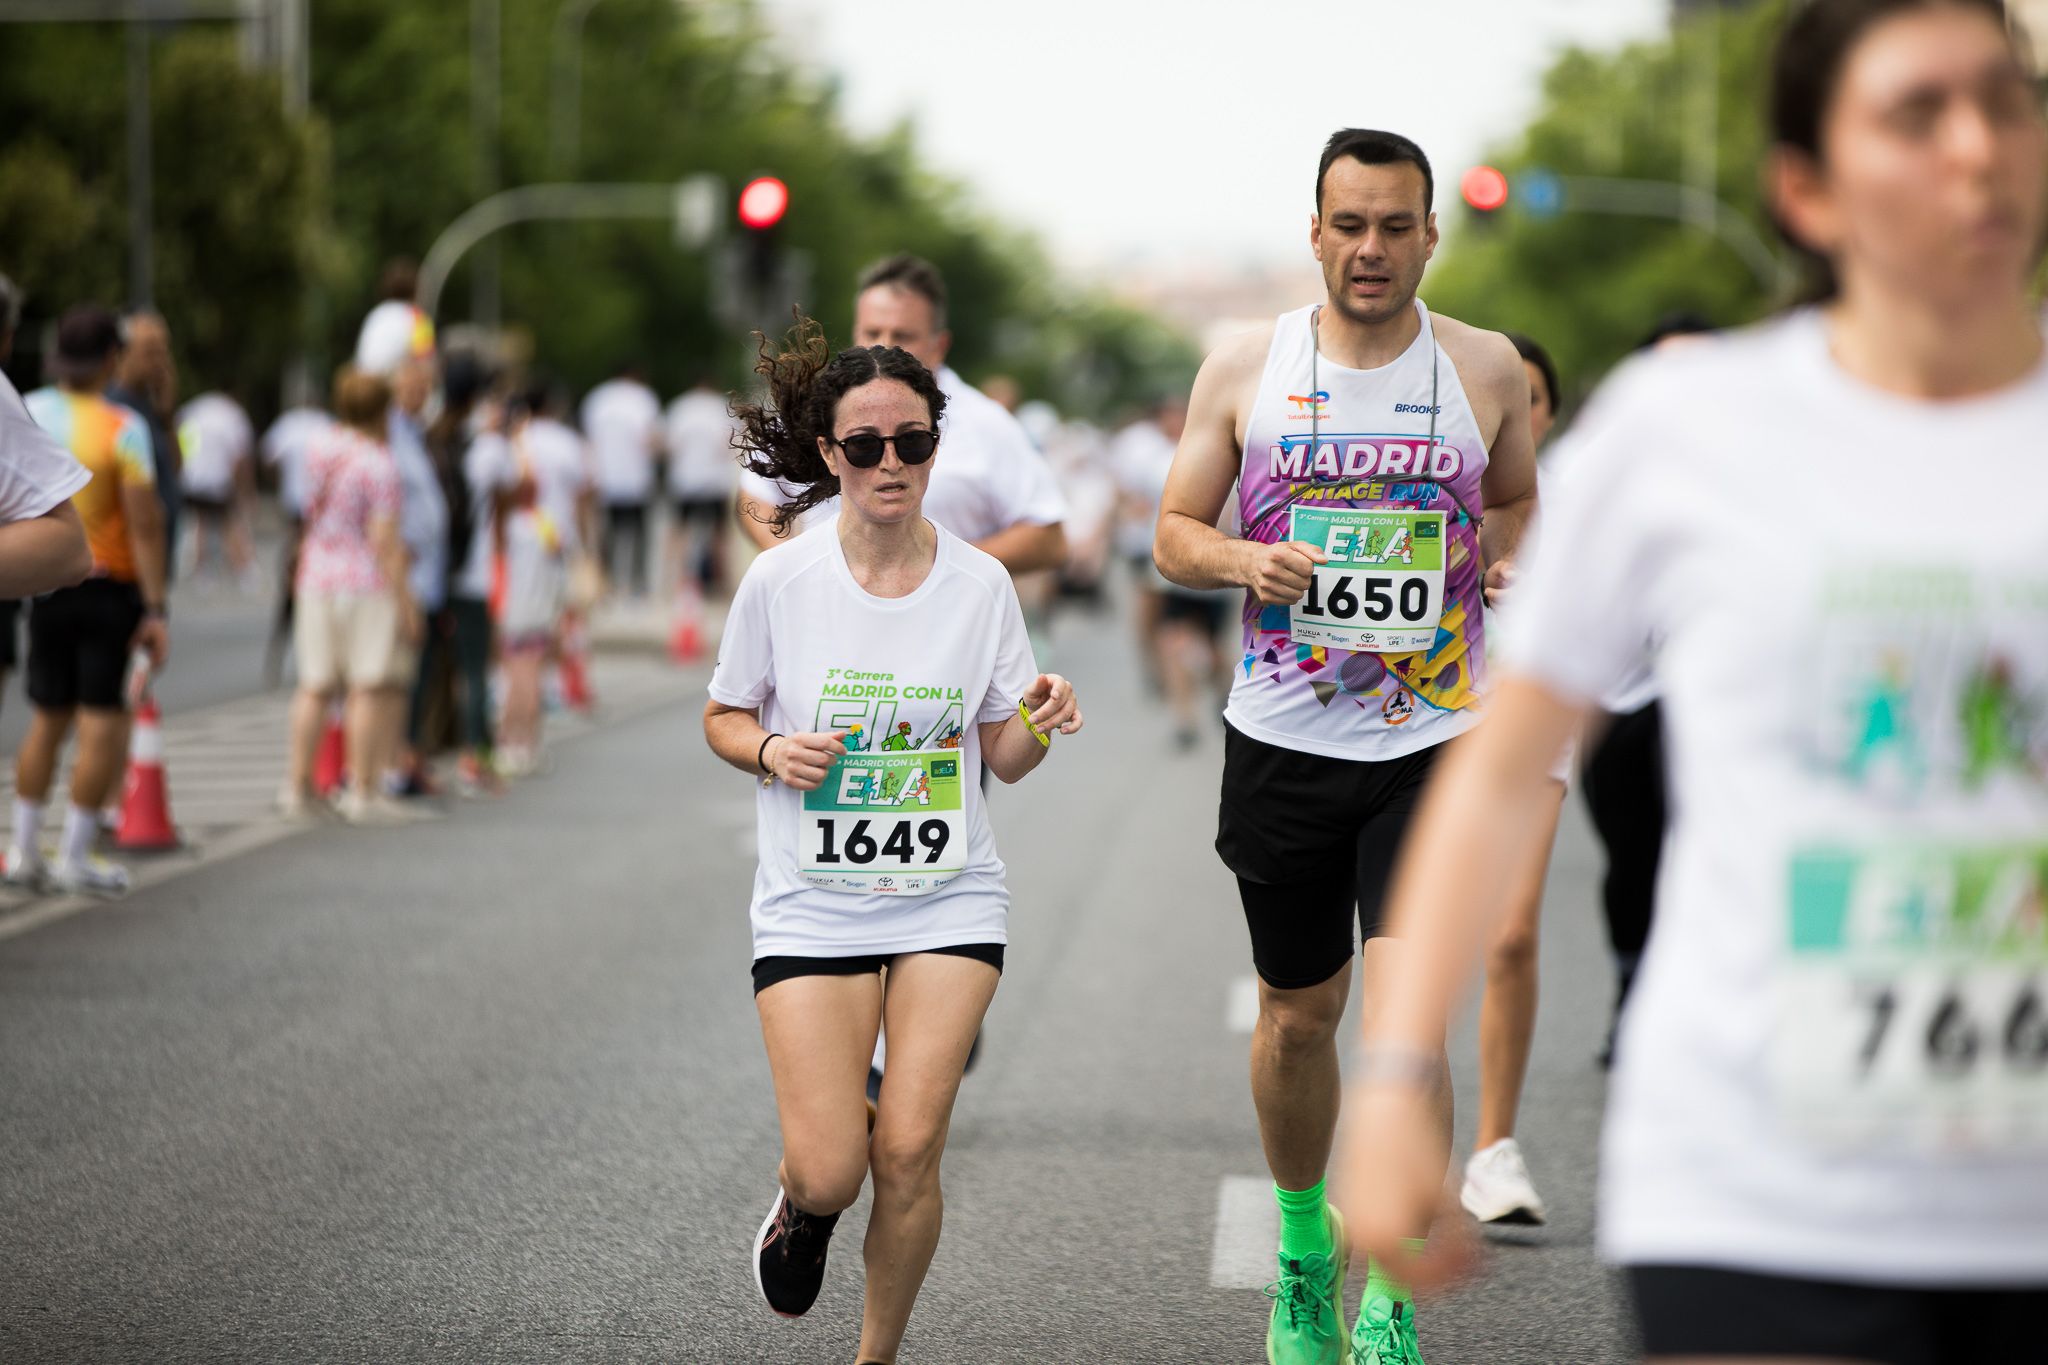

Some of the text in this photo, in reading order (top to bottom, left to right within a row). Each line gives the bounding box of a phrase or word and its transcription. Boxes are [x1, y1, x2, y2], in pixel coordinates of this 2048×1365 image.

[1394, 403, 1441, 415] BROOKS
[1270, 442, 1463, 482] MADRID
[1389, 483, 1441, 501] RUN
[1331, 516, 1370, 526] MADRID
[1373, 517, 1394, 526] CON
[1395, 517, 1408, 526] LA
[1325, 524, 1413, 564] ELA
[1302, 574, 1429, 621] 1650
[1297, 629, 1321, 637] MUKUA
[1331, 635, 1350, 643] Biogen
[843, 669, 894, 681] Carrera
[822, 683, 963, 701] MADRID CON LA
[843, 758, 922, 767] MADRID CON LA
[836, 767, 929, 806] ELA
[816, 818, 950, 864] 1649
